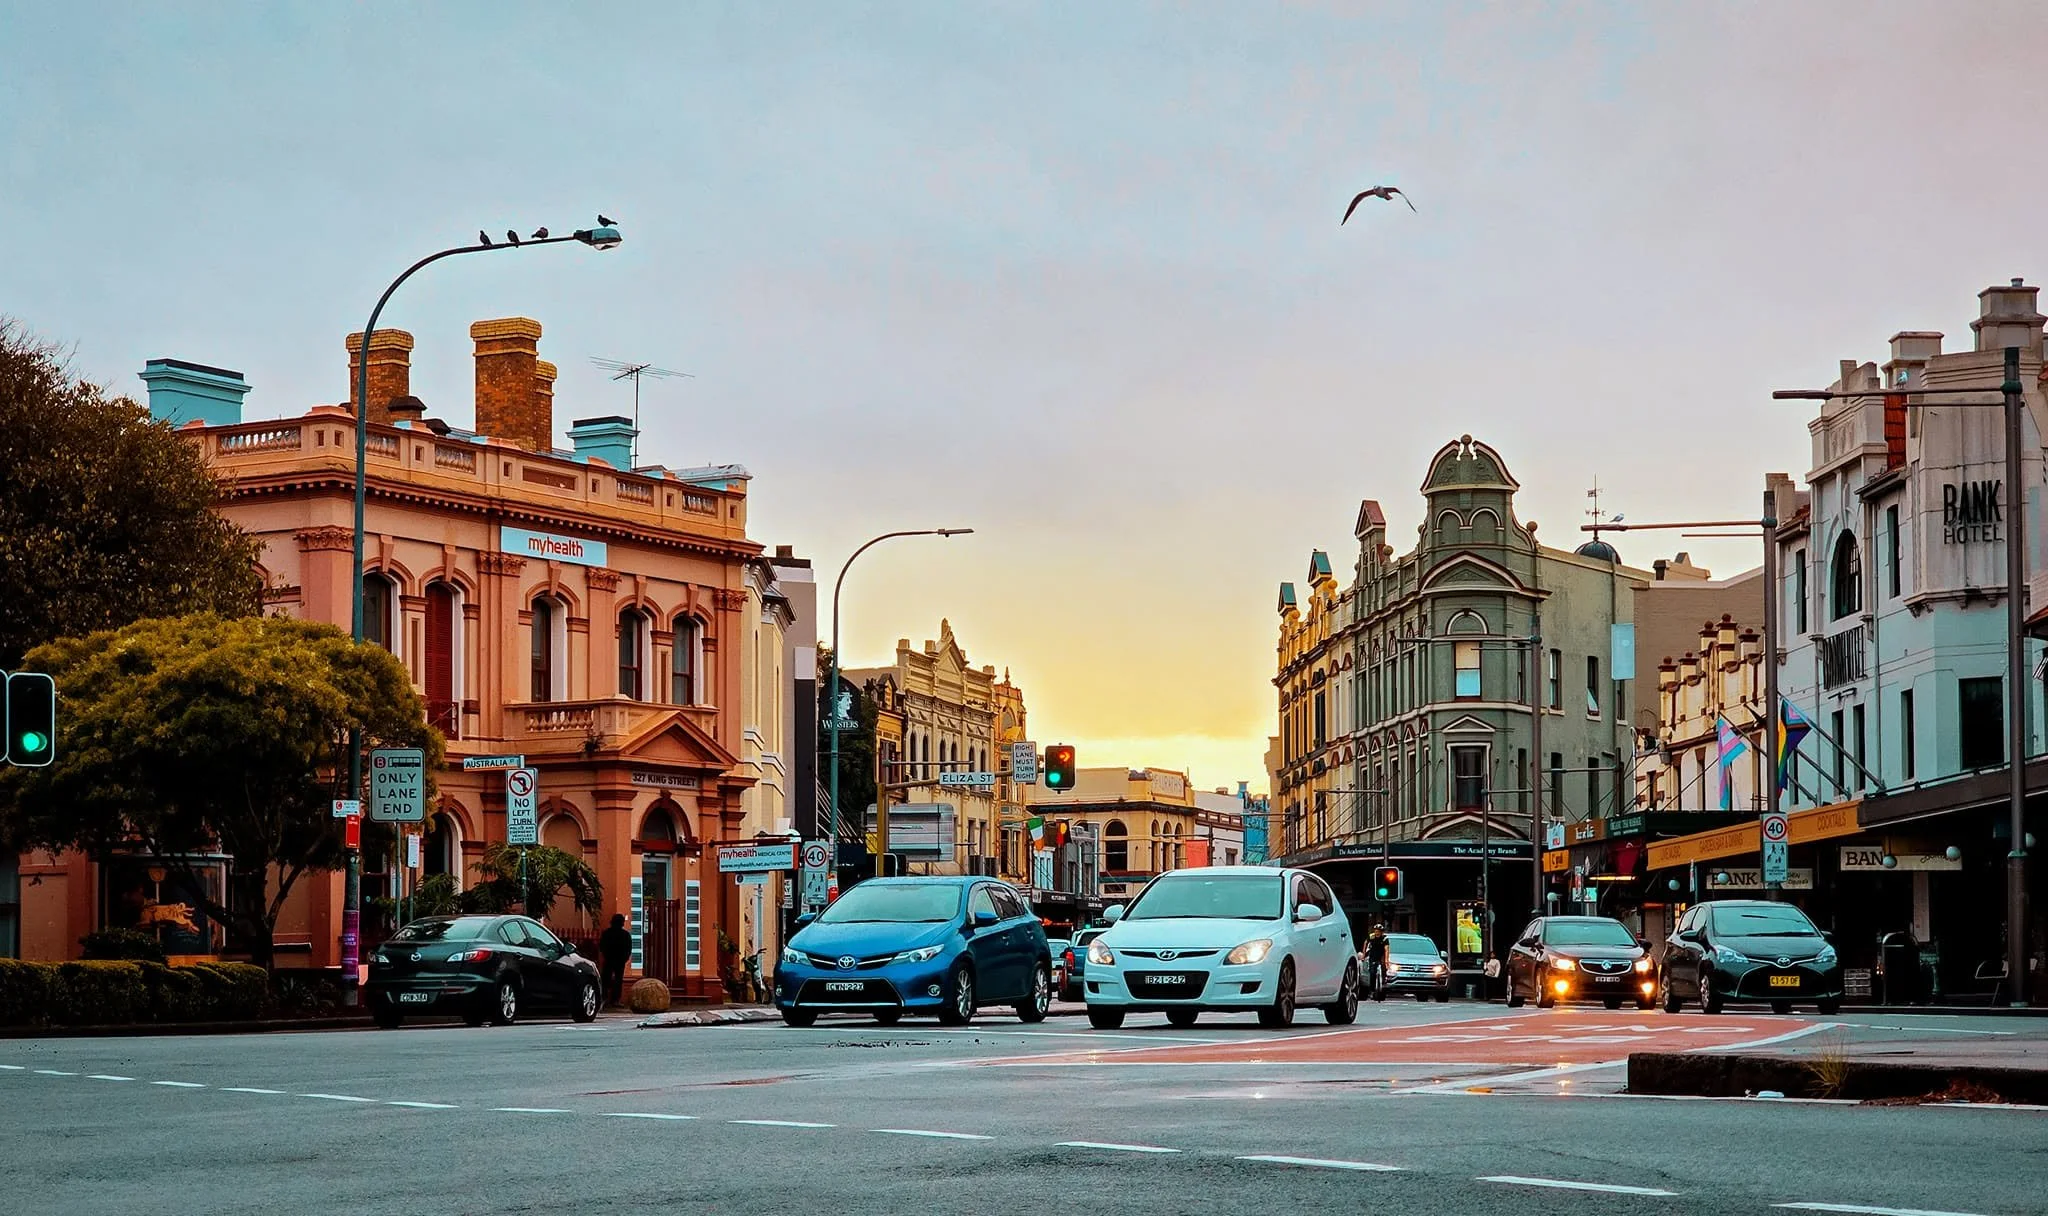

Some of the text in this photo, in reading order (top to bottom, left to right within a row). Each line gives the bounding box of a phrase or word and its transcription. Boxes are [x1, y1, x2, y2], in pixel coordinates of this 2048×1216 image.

[1943, 480, 2002, 526] BANK
[1944, 524, 2005, 545] HOTEL
[528, 536, 583, 557] myhealth
[822, 720, 859, 729] WSTERS
[465, 760, 508, 768] AUSTRALIA
[378, 773, 417, 784] ONLY
[633, 773, 697, 787] 327 KING STREET
[942, 775, 992, 783] ELIZA ST
[378, 789, 417, 799] LANE
[383, 804, 412, 814] END
[514, 799, 530, 808] NO
[1817, 811, 1847, 832] COCKTAILS
[1768, 822, 1784, 834] 40
[720, 848, 757, 860] myhealth
[808, 851, 824, 862] 40
[1468, 847, 1496, 855] Acadmy
[1845, 851, 1883, 866] BAN
[1378, 1034, 1658, 1044] BUS
